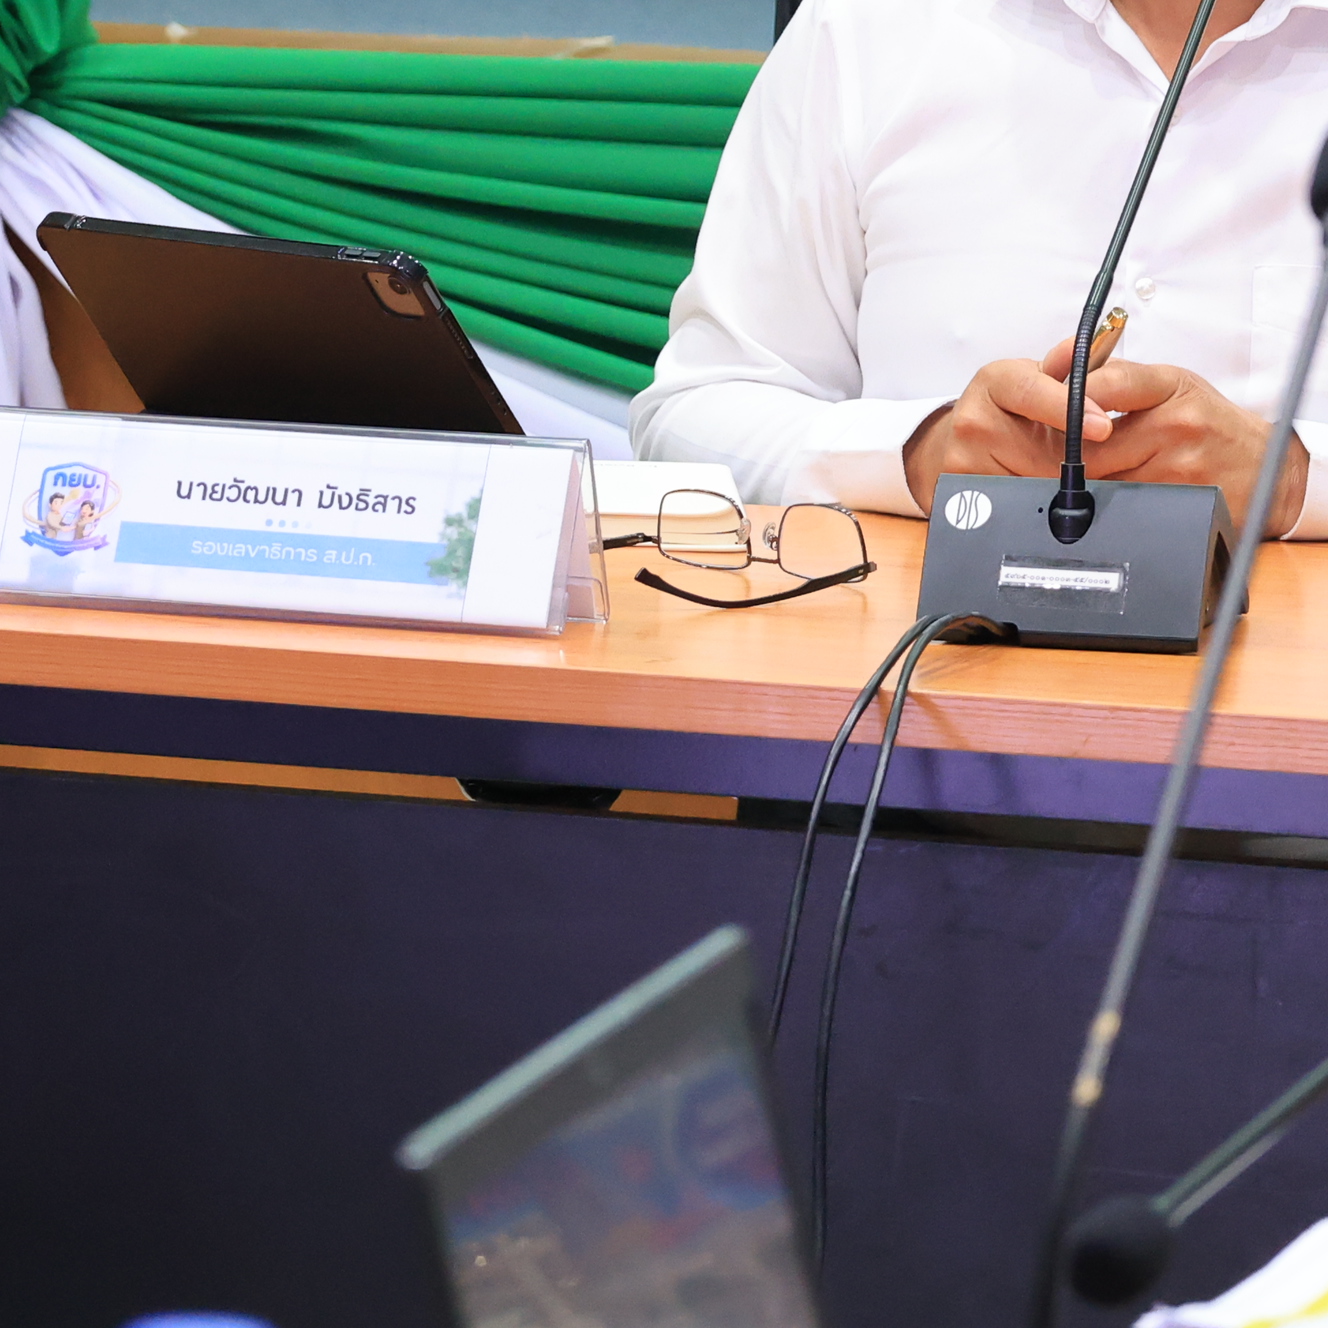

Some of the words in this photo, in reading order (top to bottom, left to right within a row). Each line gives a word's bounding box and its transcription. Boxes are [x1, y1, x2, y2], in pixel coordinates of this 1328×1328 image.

[176, 477, 303, 508] นายวัฒนา
[317, 483, 417, 515] มังธิสาร
[191, 539, 318, 562] รองเลขาธิการ
[323, 548, 377, 566] ส.ป.ก.
